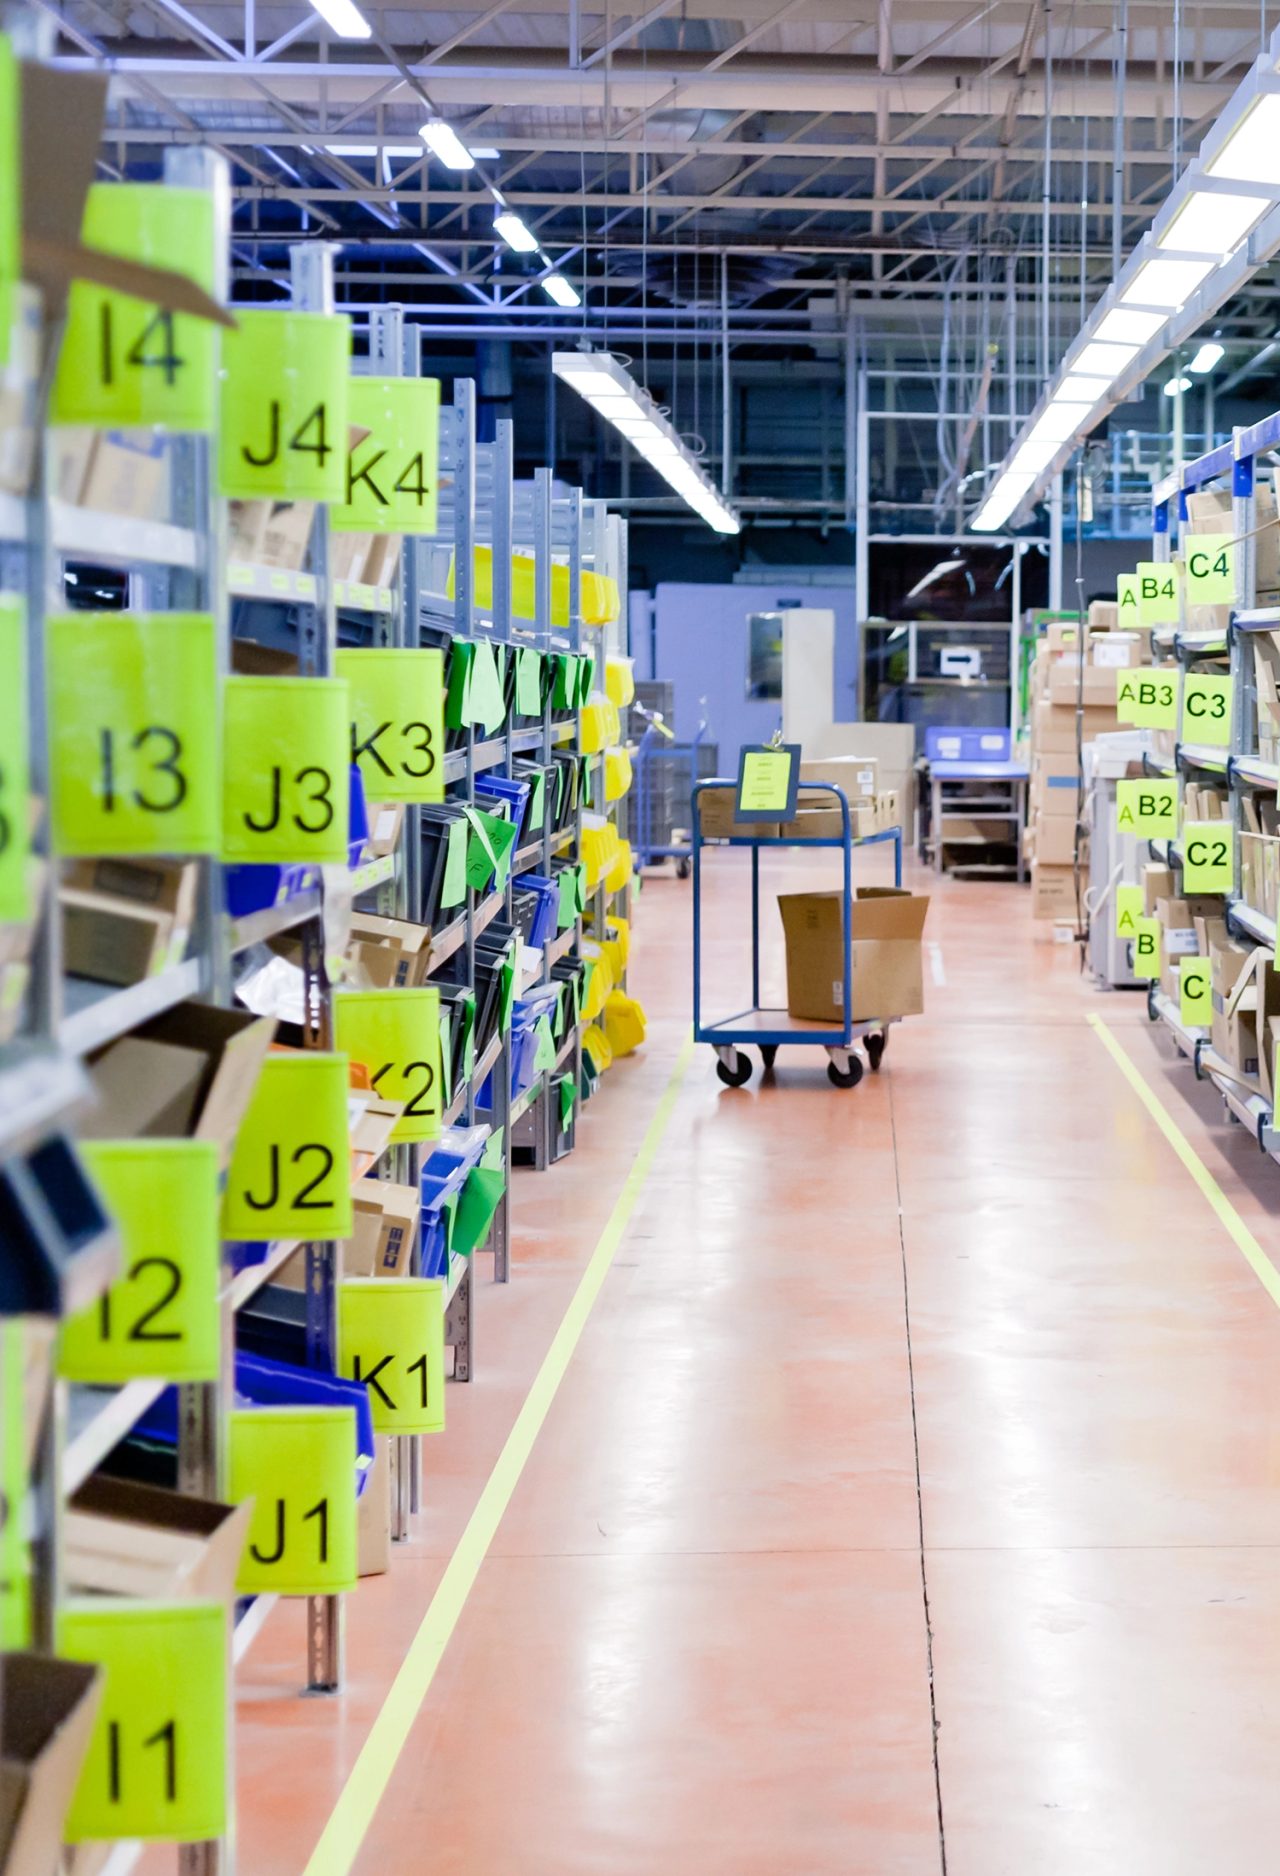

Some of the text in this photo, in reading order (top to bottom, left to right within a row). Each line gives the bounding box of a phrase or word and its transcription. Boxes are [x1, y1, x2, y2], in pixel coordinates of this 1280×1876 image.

[100, 302, 184, 387] I4
[241, 399, 332, 468] J4
[346, 450, 428, 506] K4
[1142, 577, 1175, 599] B4
[1189, 552, 1230, 577] C4
[1140, 684, 1172, 706] B3
[1187, 692, 1225, 718] C3
[102, 727, 187, 814] I3
[351, 721, 435, 777] K3
[244, 767, 333, 833] J3
[1139, 795, 1173, 817] B2
[1187, 841, 1227, 867] C2
[1183, 974, 1209, 1000] C
[244, 1144, 333, 1211] J2
[100, 1257, 183, 1342] I2
[353, 1354, 427, 1410] K1
[250, 1499, 327, 1564] J1
[109, 1720, 176, 1803] I1
